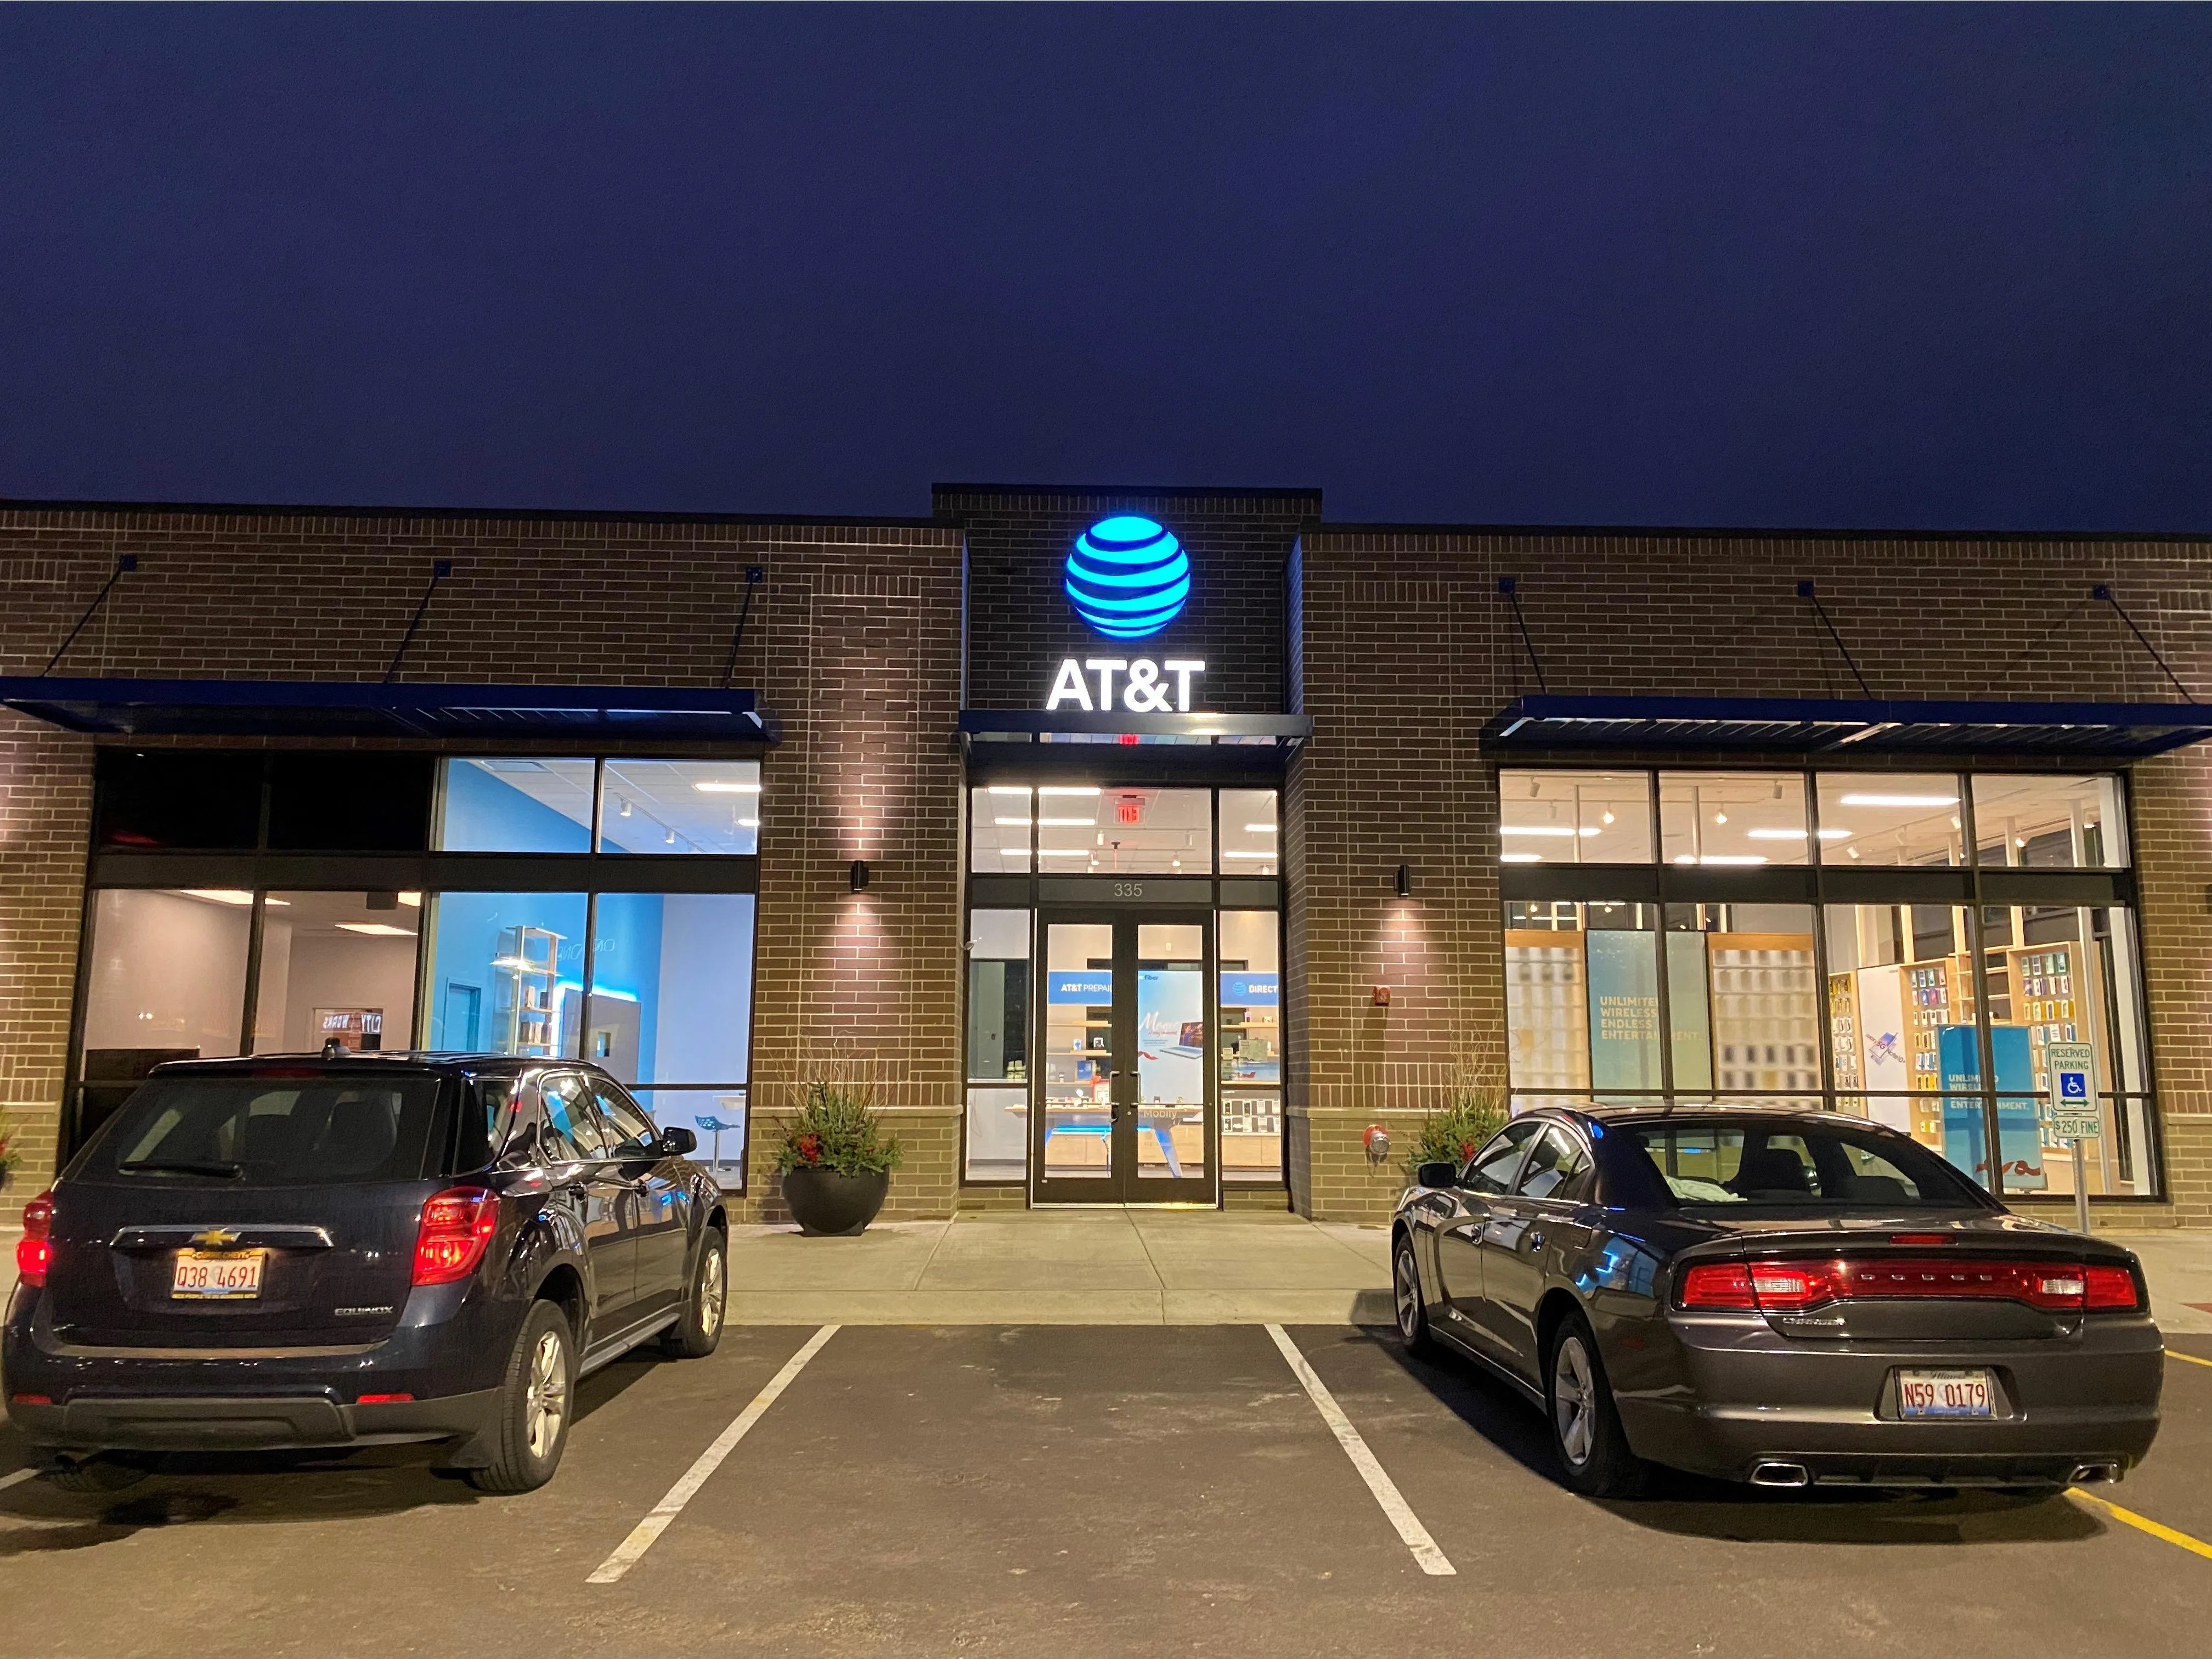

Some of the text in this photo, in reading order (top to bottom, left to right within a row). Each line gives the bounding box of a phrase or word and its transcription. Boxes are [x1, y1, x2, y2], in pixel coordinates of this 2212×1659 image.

[1046, 659, 1205, 712] AT&T
[1114, 883, 1142, 896] 335
[1061, 984, 1082, 992] AT&T
[1600, 1007, 1657, 1018] WIRELESS
[1601, 1018, 1652, 1029] ENDLESS
[1876, 1041, 1886, 1049] 5G
[2051, 1048, 2090, 1058] RESERVED
[2055, 1060, 2089, 1070] PARKING
[2081, 1121, 2099, 1134] FINE
[177, 1266, 256, 1288] Q38 4691
[335, 1306, 394, 1316] EQUINOX
[1904, 1383, 1985, 1408] N59 0179
